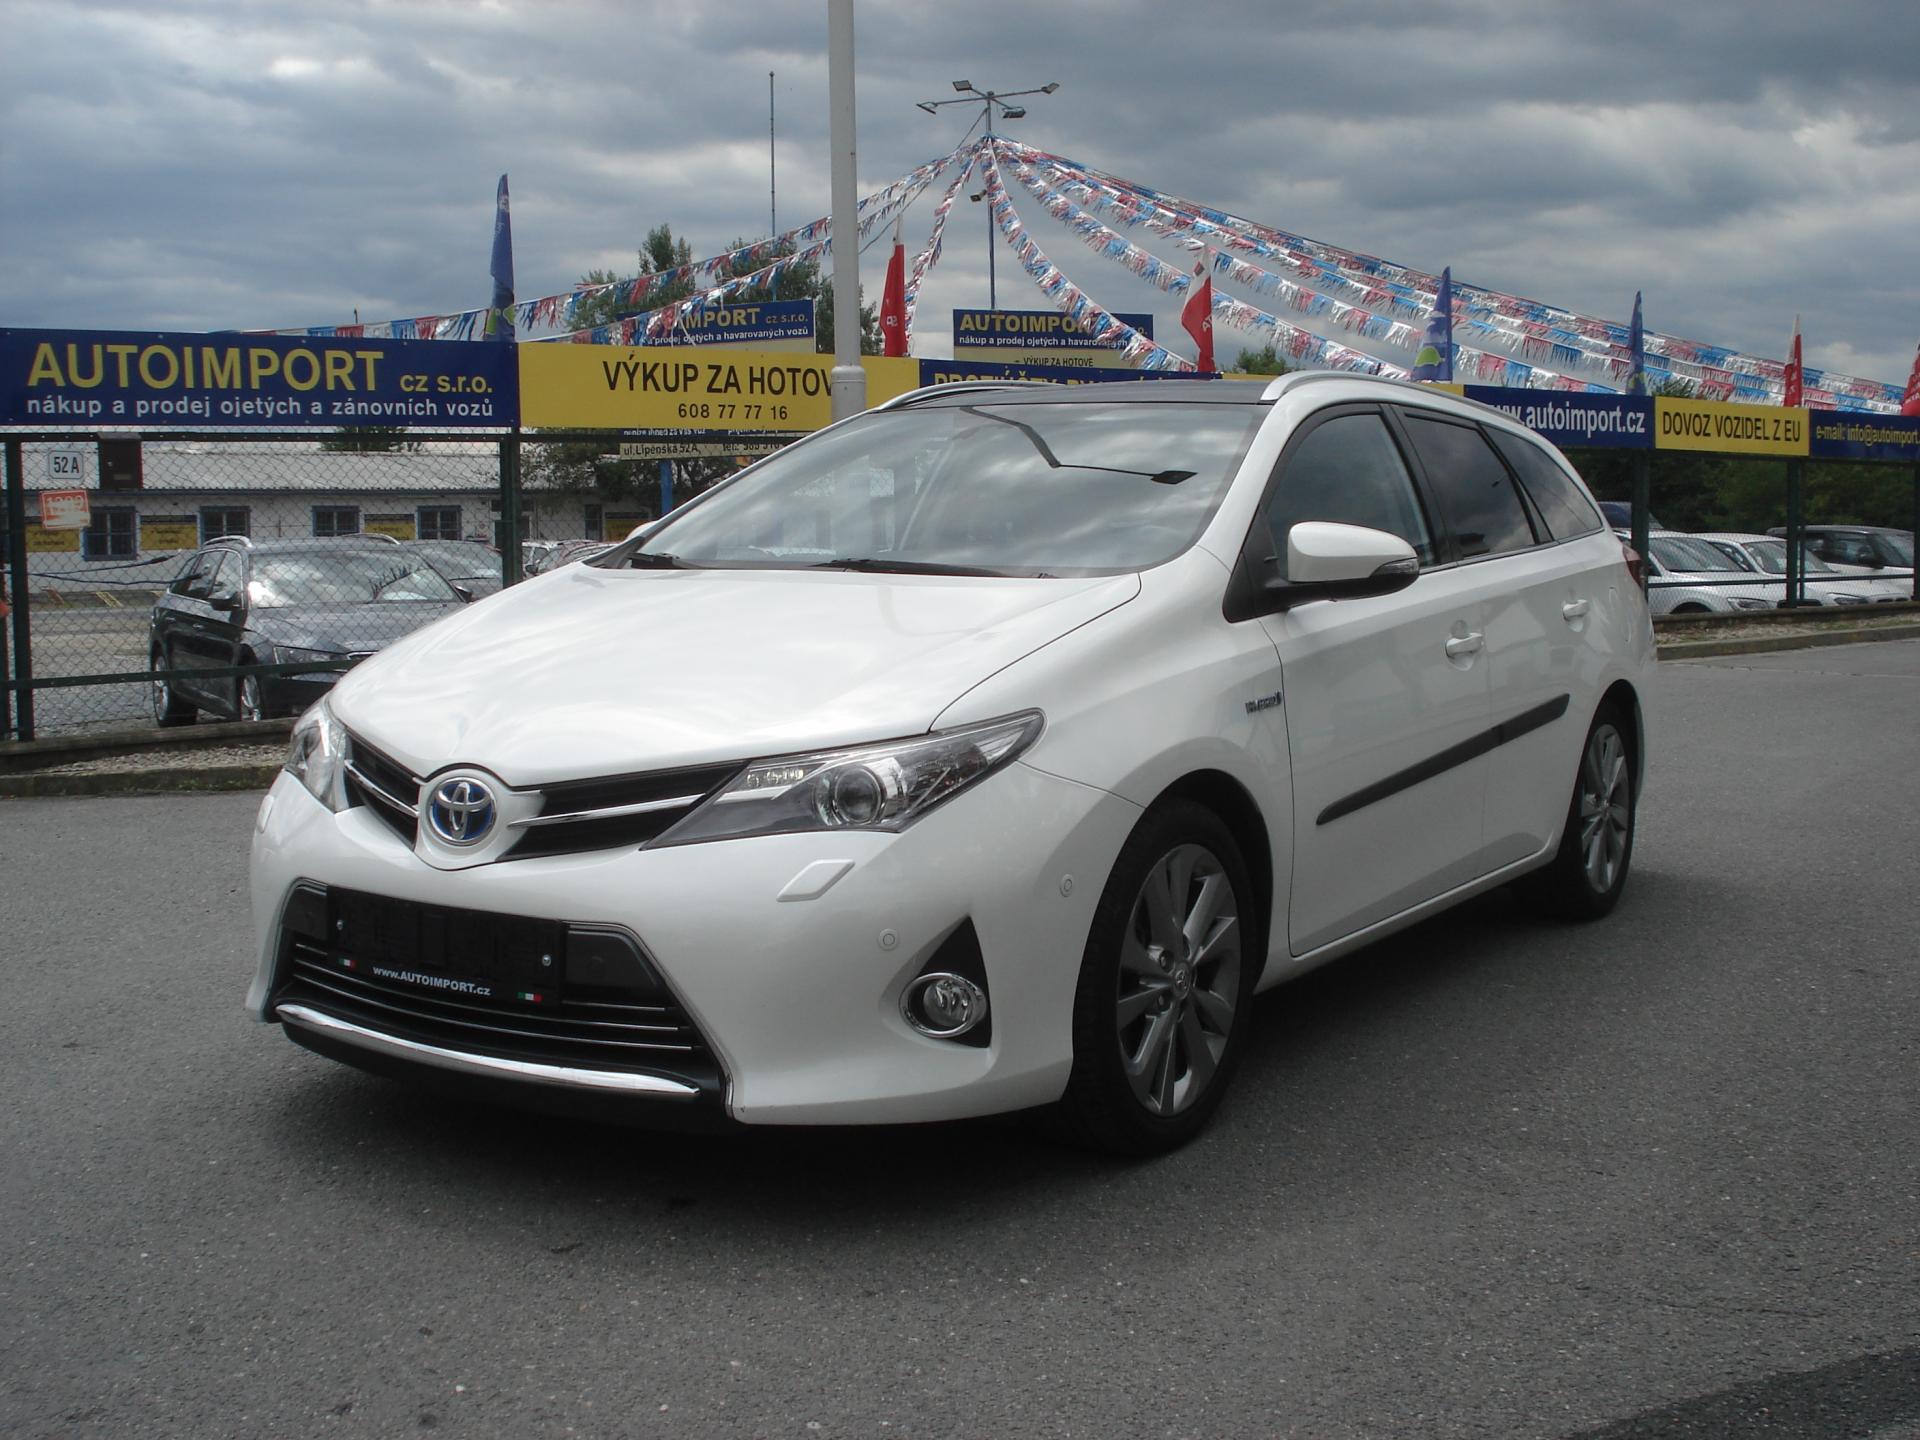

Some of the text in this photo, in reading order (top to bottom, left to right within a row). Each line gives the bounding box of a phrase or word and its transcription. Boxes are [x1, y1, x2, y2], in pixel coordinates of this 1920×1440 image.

[765, 316, 777, 325] cz
[781, 314, 808, 324] s.r.o.
[959, 314, 1086, 333] AUTOIMPO
[716, 333, 722, 341] a
[723, 328, 786, 341] havarovaných
[787, 326, 808, 336] vozů
[959, 336, 987, 346] nákup
[996, 337, 1025, 347] prodej
[1027, 337, 1058, 348] ojetých
[27, 343, 493, 393] AUTOIMPORT cz s.r.o.
[1023, 355, 1049, 367] VÝKUP
[1050, 358, 1061, 367] ZA
[603, 352, 832, 396] VÝKUP ZA HOTOV
[27, 395, 493, 418] nákup a prodej ojetých a zánovních vozů
[678, 403, 787, 420] 608 77 77 16
[1488, 401, 1645, 438] w.autoimport.cz
[1662, 411, 1801, 442] DOVOZ VOZIDEL Z EU
[1816, 422, 1846, 440] e-mail:
[53, 456, 80, 474] 52 A
[372, 966, 491, 996] www.AUTOIMPORT.cz
